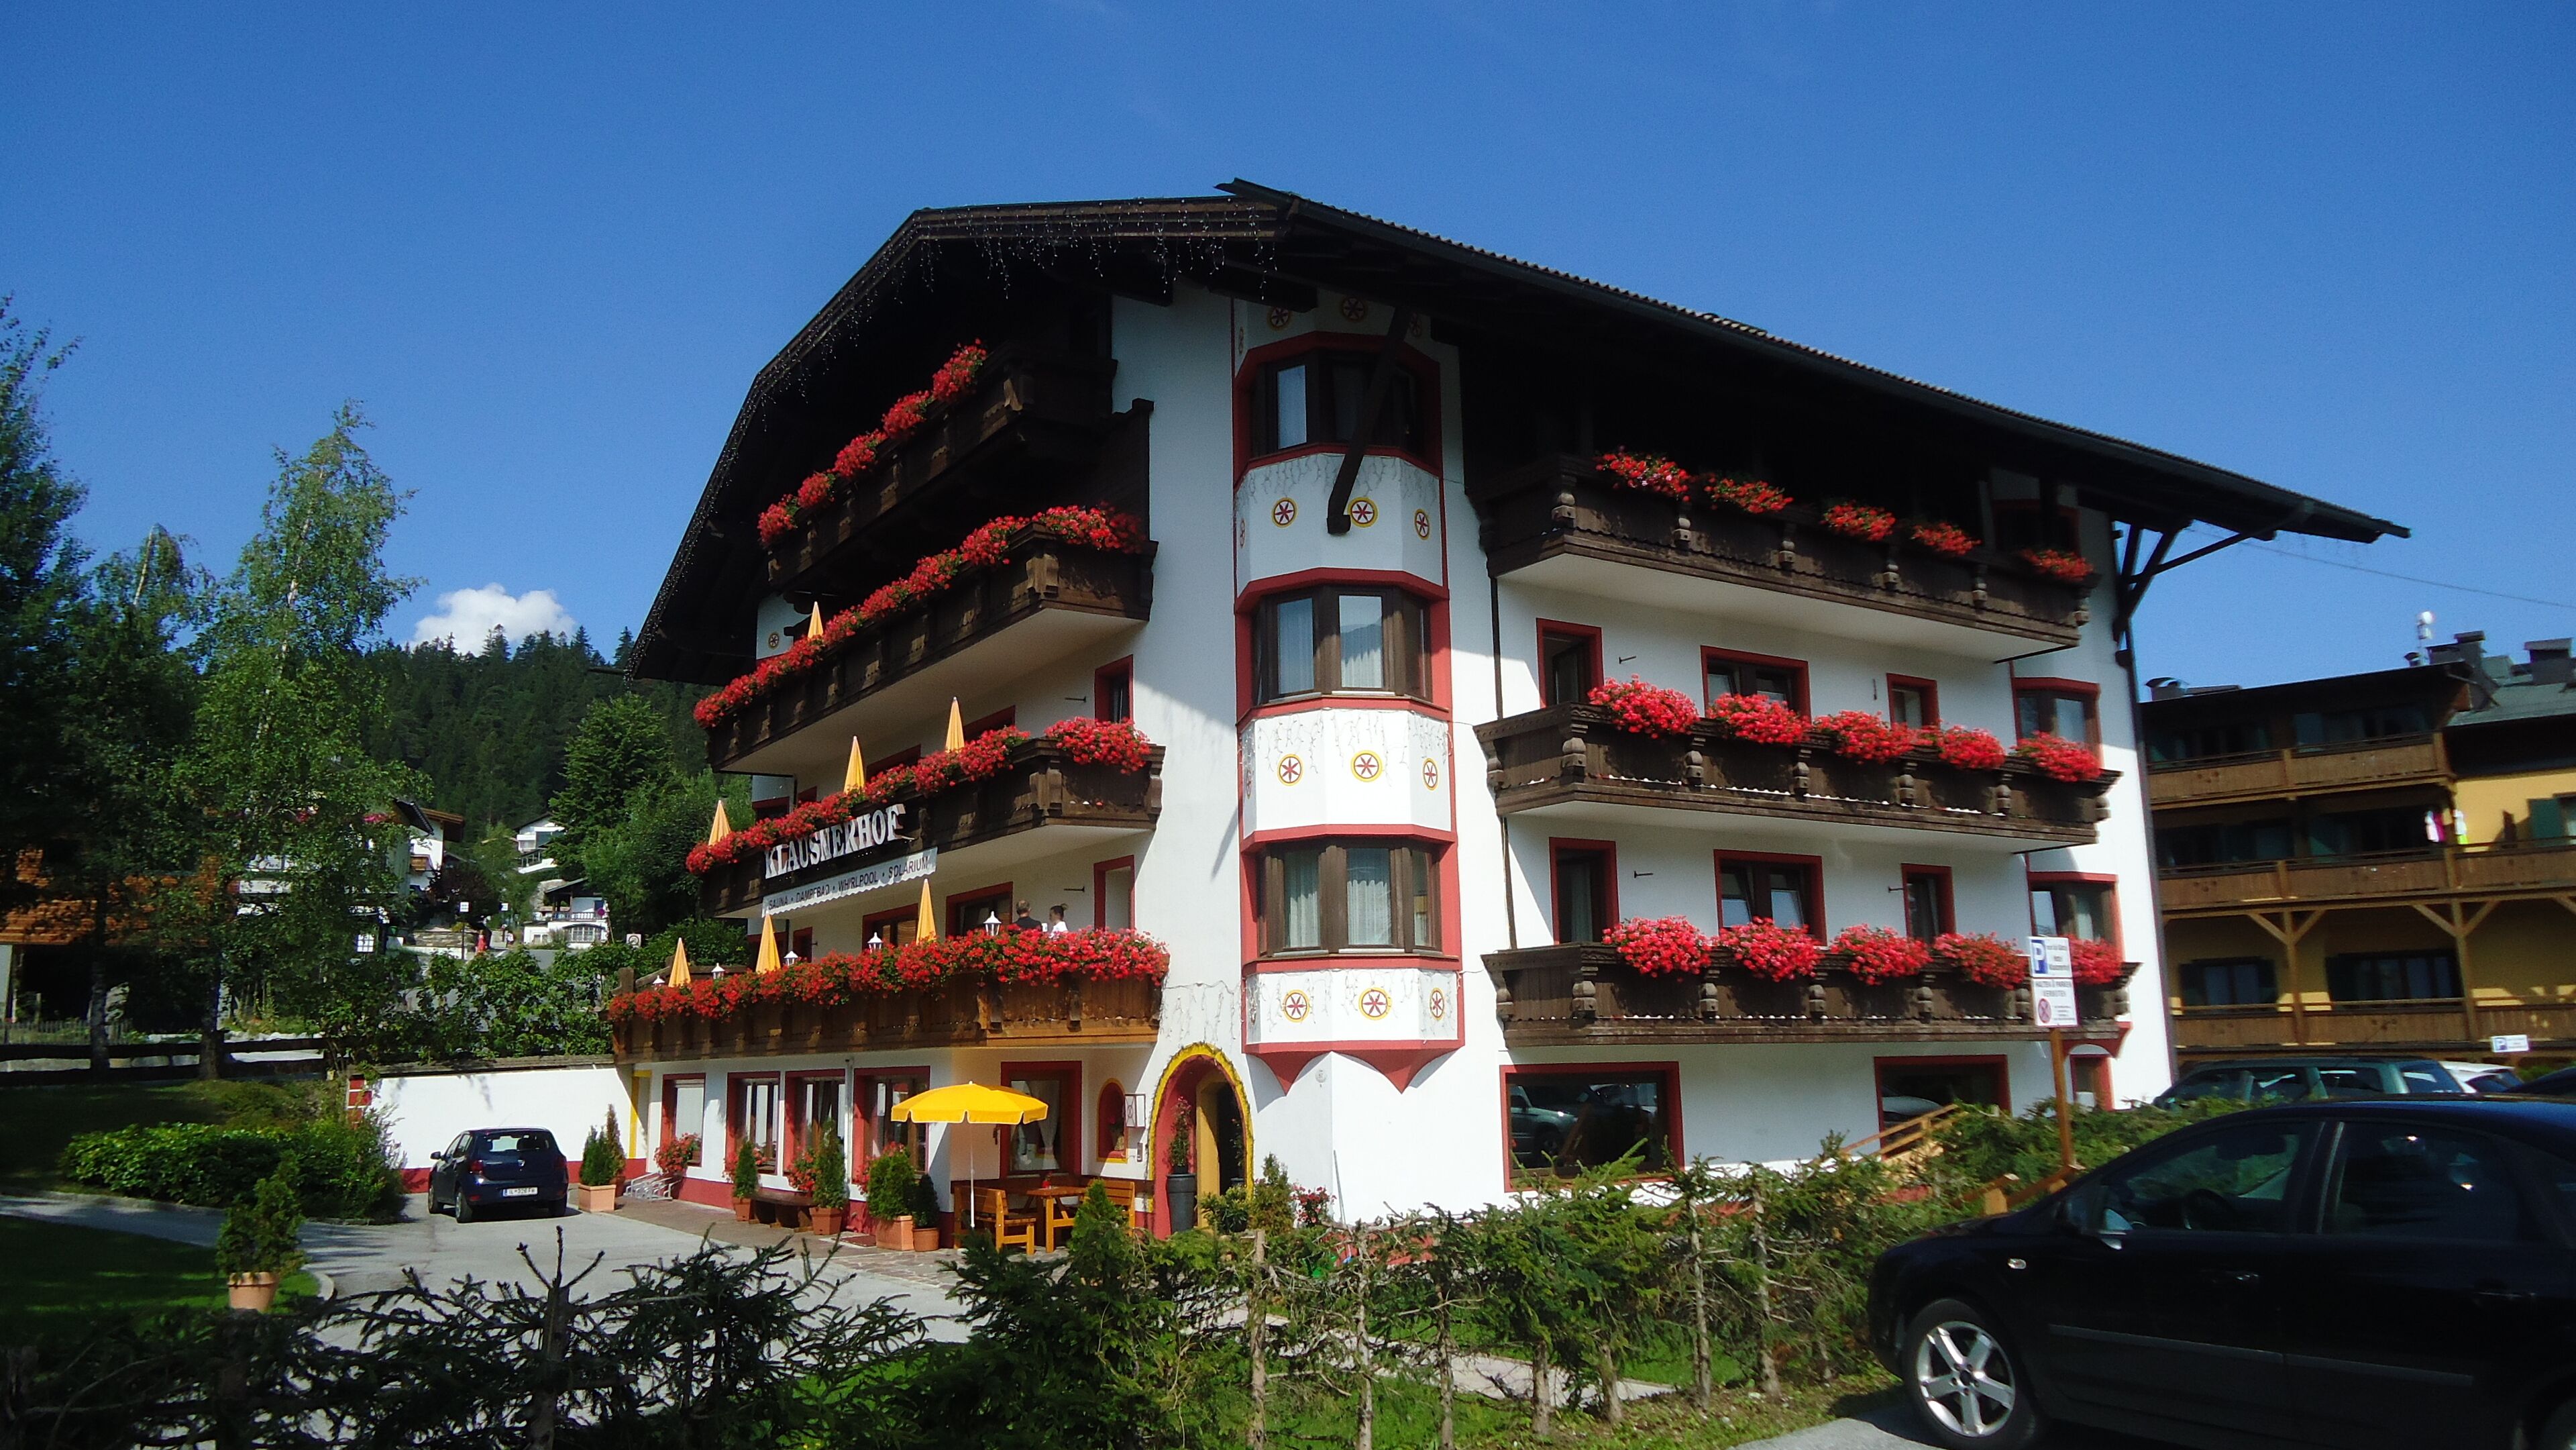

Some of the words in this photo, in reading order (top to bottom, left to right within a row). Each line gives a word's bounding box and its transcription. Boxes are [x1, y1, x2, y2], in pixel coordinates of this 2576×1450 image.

[765, 803, 903, 879] KLAUSNERHOF
[768, 896, 788, 911] SAUNA
[796, 884, 830, 903] DAMPFBAD
[838, 870, 879, 892] WHIRLPOOL
[888, 856, 929, 879] SOLARIUM
